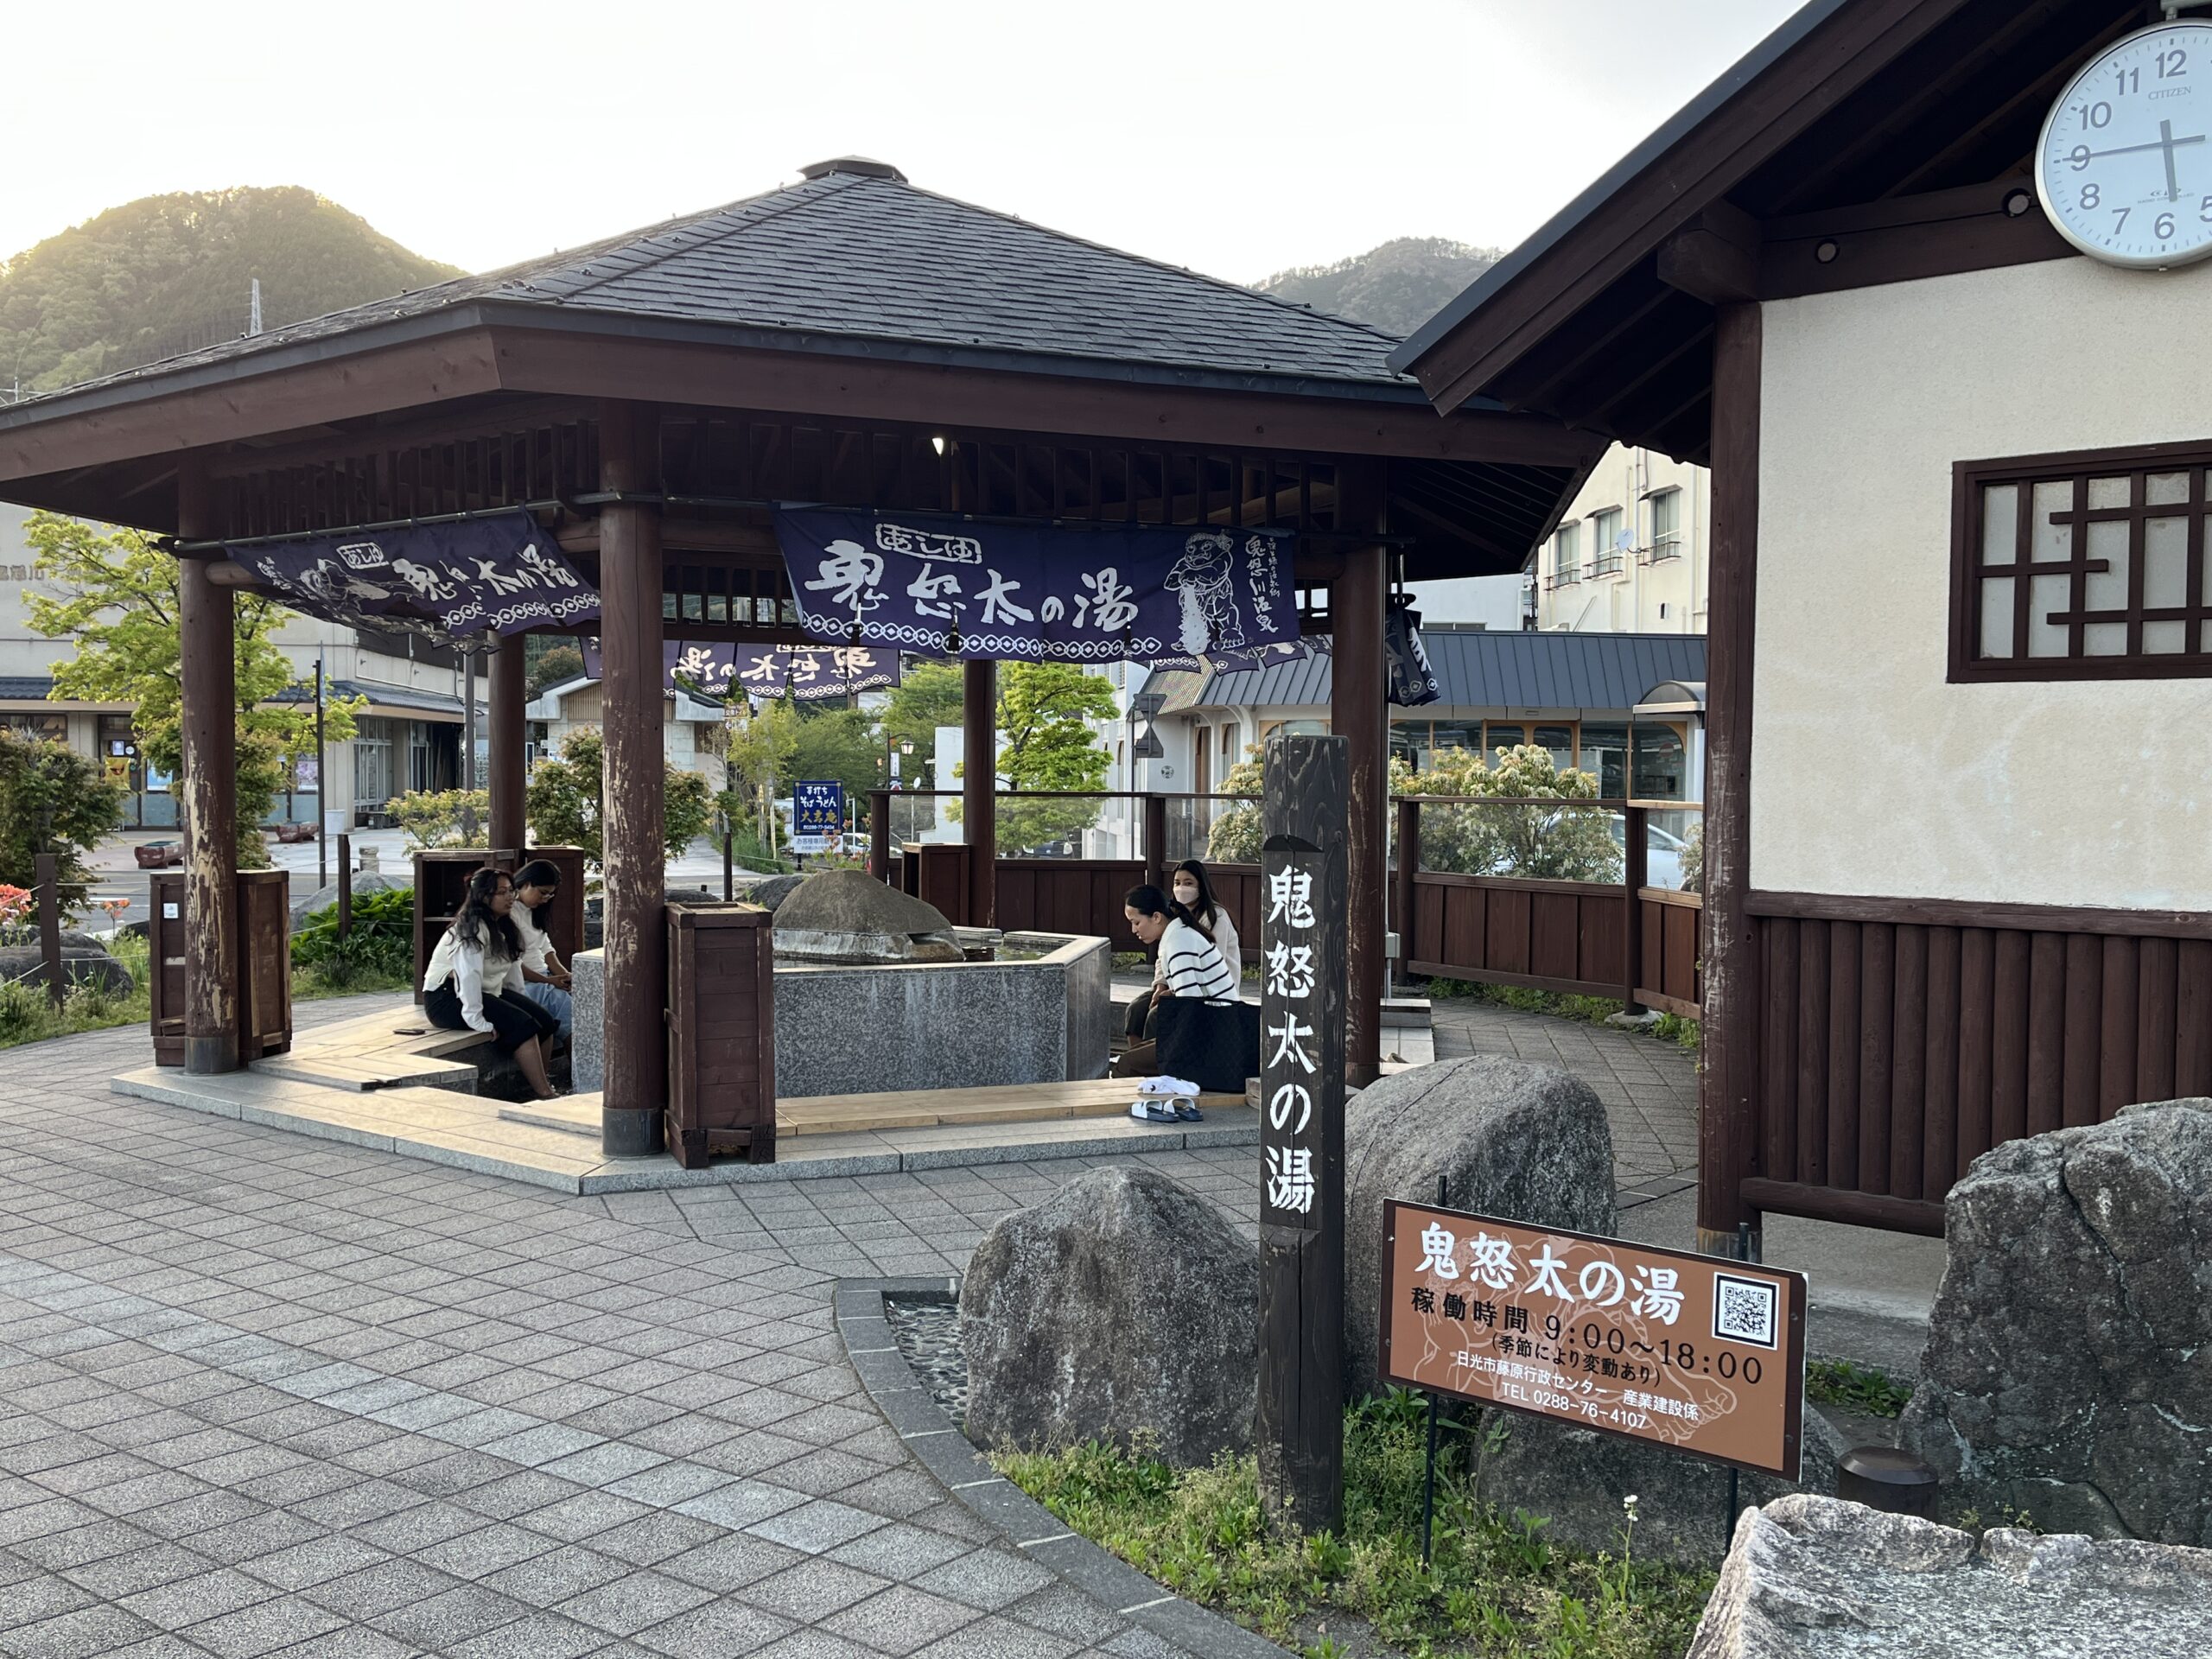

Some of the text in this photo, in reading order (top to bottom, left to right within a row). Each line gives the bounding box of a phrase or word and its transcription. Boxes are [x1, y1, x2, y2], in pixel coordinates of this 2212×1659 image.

[2155, 49, 2187, 79] 12
[2115, 67, 2139, 96] 11
[2148, 86, 2191, 100] CITIZEN
[2079, 101, 2112, 130] 10
[2070, 144, 2091, 171] 9
[2079, 183, 2101, 210] 8
[2112, 207, 2131, 235] 7
[2154, 213, 2175, 239] 6
[804, 539, 1139, 632] 鬼怒太の湯
[1265, 863, 1318, 1215] 鬼怒太の湯
[1414, 1222, 1685, 1326] 鬼怒太の湯
[1410, 1286, 1529, 1335] 稼働時間
[1456, 1350, 1700, 1422] 日光市藤原行政センター 産業建設係
[1502, 1382, 1648, 1429] TEL 0288-76-4107
